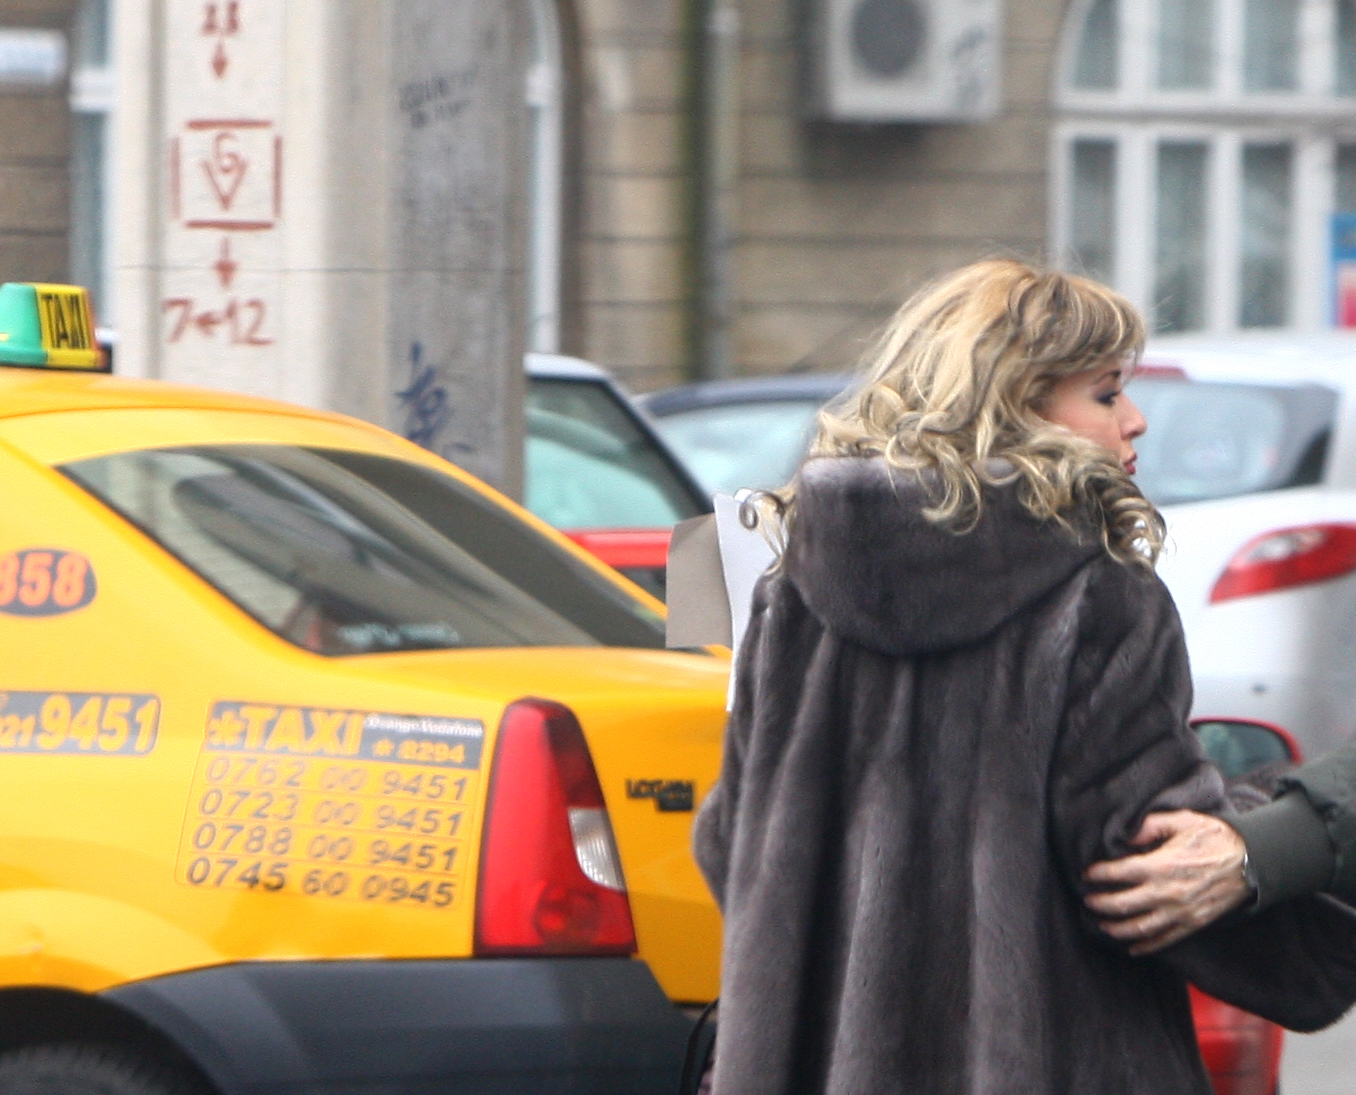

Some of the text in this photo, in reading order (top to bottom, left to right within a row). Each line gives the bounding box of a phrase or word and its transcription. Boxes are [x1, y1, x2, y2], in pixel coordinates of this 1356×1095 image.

[41, 292, 87, 349] TAXI
[321, 766, 368, 791] 00
[383, 770, 468, 801] 9451
[200, 788, 463, 836] 0723 00 9451
[192, 821, 459, 871] 0788 00 9451
[186, 856, 456, 908] 0745 60 0945
